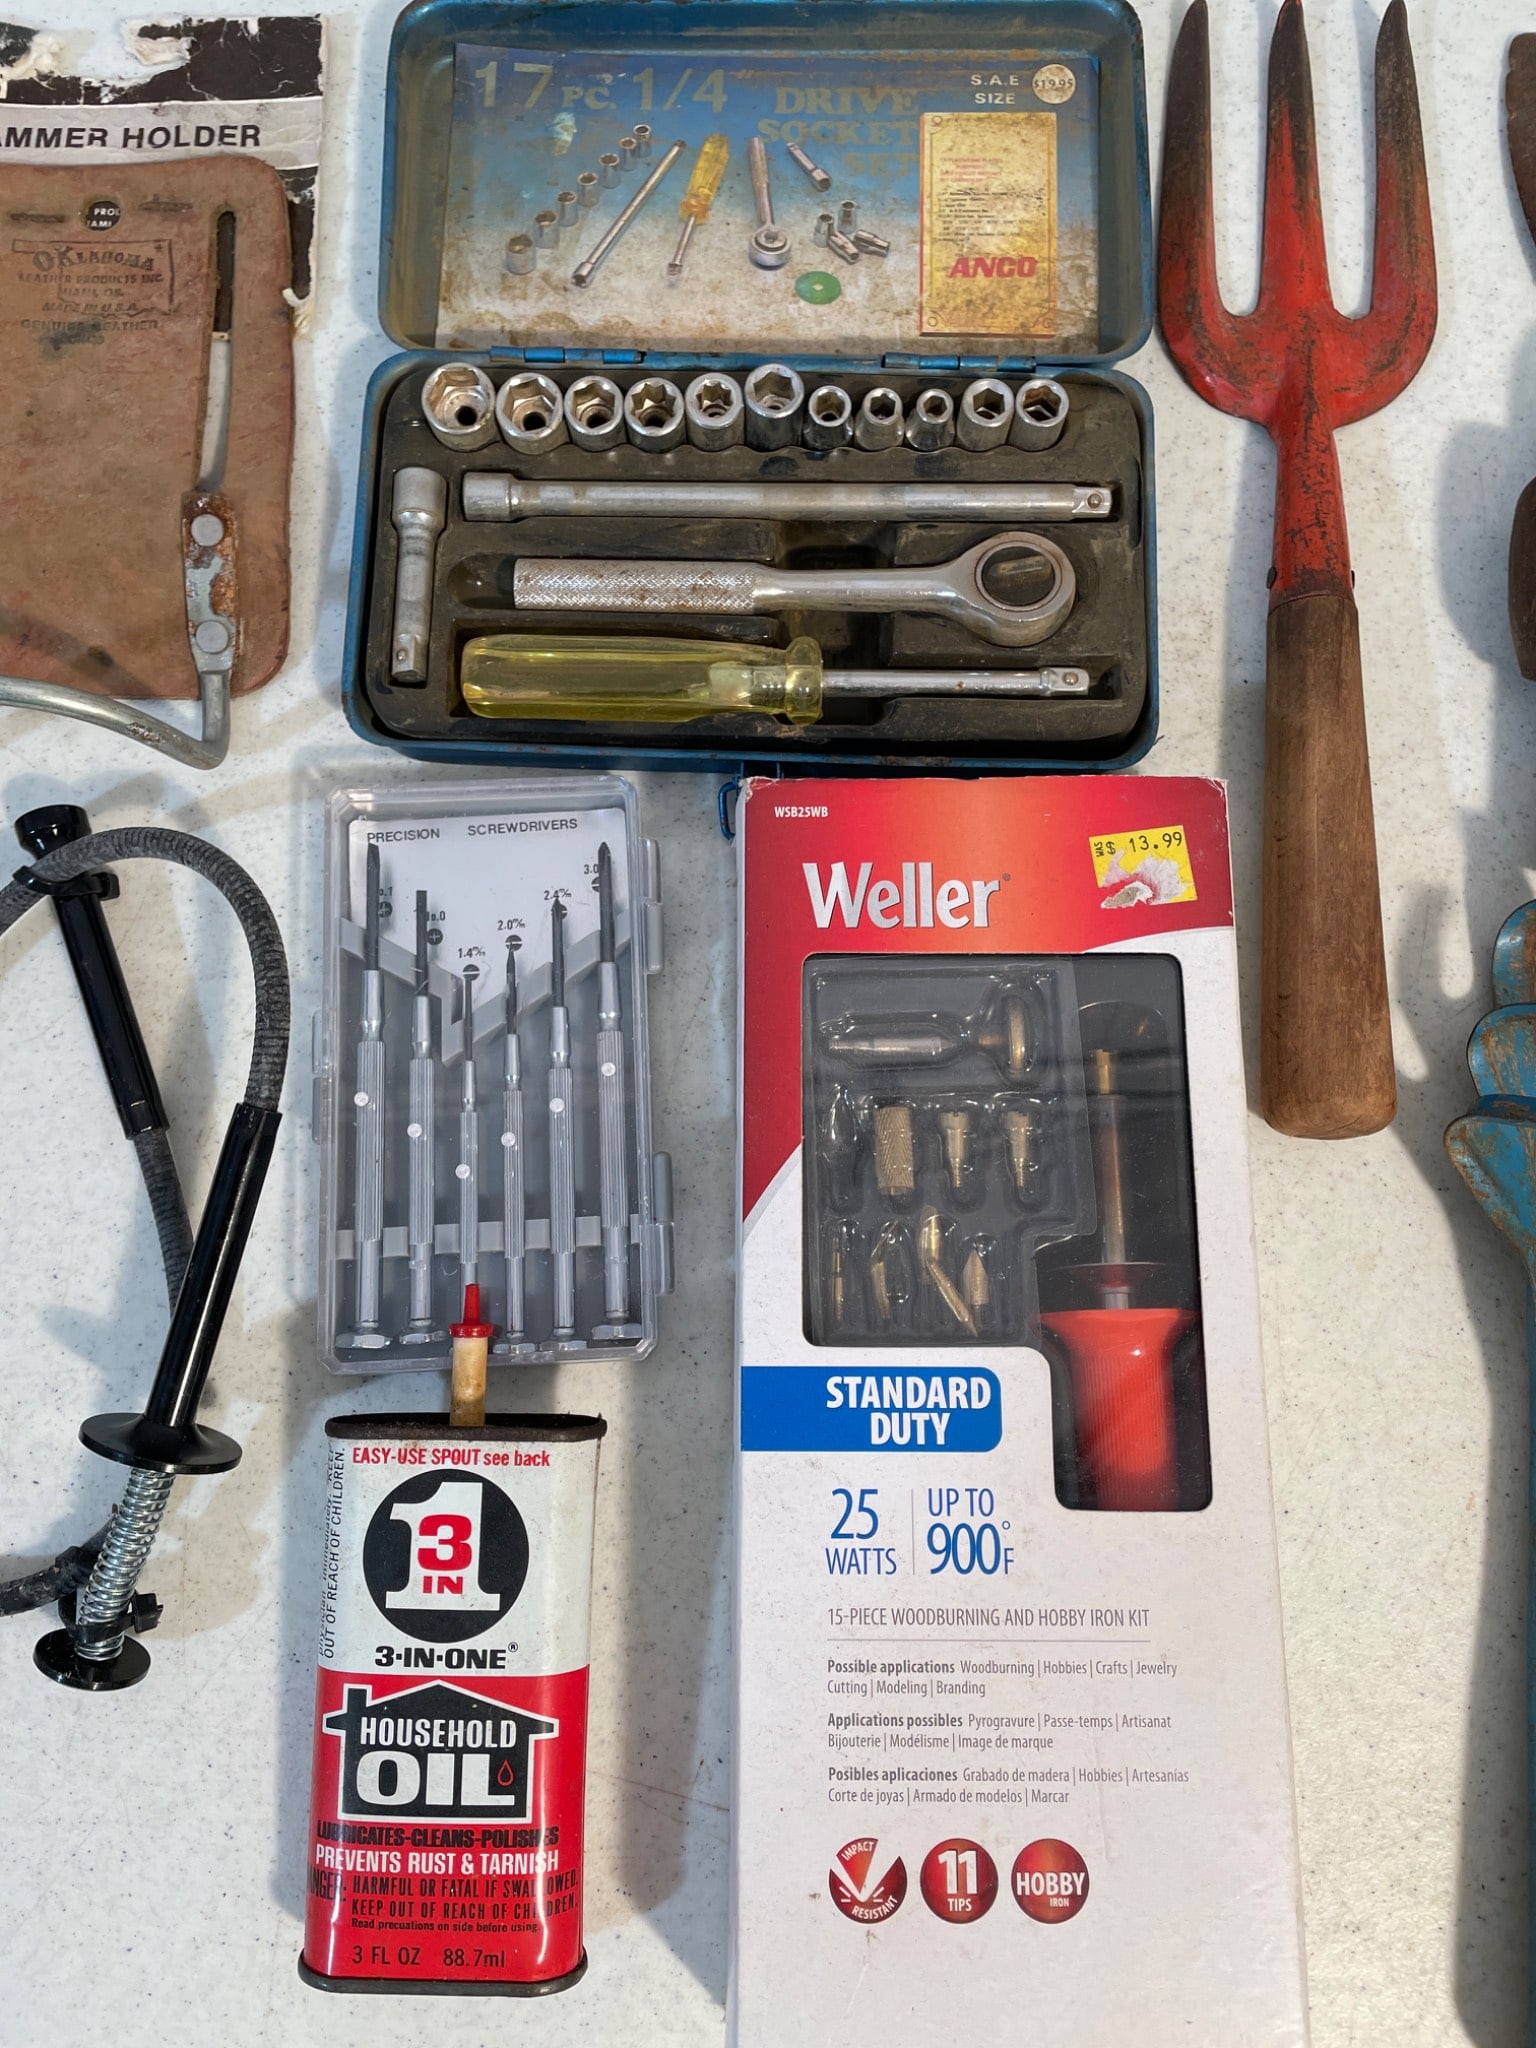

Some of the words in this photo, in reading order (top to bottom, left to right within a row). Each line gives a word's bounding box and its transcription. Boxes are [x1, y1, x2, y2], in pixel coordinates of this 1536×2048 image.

[475, 61, 553, 109] 17
[775, 86, 919, 115] DRIVE
[975, 92, 1016, 105] SIZE
[122, 125, 261, 149] HOLDER
[757, 119, 918, 146] SOCKET
[844, 153, 918, 177] SET
[33, 245, 154, 272] OKLAHOMA
[949, 256, 1039, 279] ANCO
[774, 806, 829, 819] WSB25WB
[366, 828, 441, 844] PRECISION
[467, 818, 578, 836] SCREWDRIVERS
[1128, 831, 1183, 853] 13.99
[802, 861, 1000, 929] Weller
[826, 1376, 991, 1409] STANDARD
[870, 1412, 951, 1446] DUTY
[352, 1447, 426, 1466] EASY-USE
[431, 1449, 481, 1466] SPOUT
[483, 1452, 509, 1466] see
[514, 1451, 551, 1467] back
[331, 1448, 346, 1527] CHILDREN.
[830, 1488, 880, 1540] 25
[928, 1488, 959, 1516] UP
[965, 1488, 994, 1516] TO
[330, 1528, 341, 1549] OF
[417, 1514, 473, 1572] 3
[826, 1547, 897, 1575] WATTS
[329, 1552, 340, 1601] REACH
[422, 1575, 463, 1595] IN
[327, 1604, 337, 1625] OF
[827, 1608, 887, 1627] 15-PIECE
[892, 1608, 1000, 1628] WOODBURNING
[1004, 1609, 1034, 1627] AND
[1038, 1609, 1086, 1628] HOBBY
[1090, 1609, 1124, 1628] IRON
[1128, 1609, 1150, 1628] KIT
[324, 1626, 335, 1659] OUT
[827, 1659, 877, 1674] Possible
[880, 1660, 955, 1676] applications
[960, 1660, 1035, 1677] Woodburning
[1043, 1661, 1087, 1675] Hobbies
[1095, 1661, 1128, 1675] Crafts
[1136, 1661, 1177, 1678] Jewelry
[827, 1680, 868, 1697] Cutting
[876, 1680, 928, 1697] Modeling
[936, 1681, 986, 1698] Branding
[360, 1717, 517, 1748] HOUSEHOLD
[827, 1713, 904, 1730] Applications
[907, 1714, 963, 1731] possibles
[968, 1715, 1035, 1731] Pyrogravure
[1044, 1715, 1113, 1732] Passe-temps
[1122, 1715, 1172, 1729] Artisanat
[828, 1734, 881, 1751] Bijouterie
[890, 1734, 949, 1749] Modélisme
[958, 1735, 992, 1752] Image
[995, 1735, 1008, 1750] de
[1011, 1738, 1054, 1753] marque
[356, 1751, 515, 1806] OIL
[828, 1767, 878, 1782] Posibles
[881, 1768, 958, 1785] aplicaciones
[963, 1768, 1009, 1783] Grabado
[1012, 1768, 1025, 1783] de
[1028, 1769, 1070, 1784] madera
[1079, 1769, 1123, 1784] Hobbies
[828, 1788, 857, 1803] Corte
[860, 1788, 873, 1803] de
[875, 1789, 905, 1806] joyas
[913, 1788, 956, 1803] Armado
[959, 1788, 972, 1803] de
[975, 1788, 1022, 1804] modelos
[1031, 1789, 1069, 1804] Marcar
[316, 1844, 402, 1873] PREVENTS
[408, 1852, 456, 1875] RUST
[461, 1853, 474, 1875] &
[480, 1849, 559, 1875] TARNISH
[841, 1841, 875, 1861] IMPACT
[353, 1875, 414, 1896] HARMFUL
[420, 1879, 437, 1896] OR
[441, 1880, 480, 1898] FATAL
[485, 1880, 498, 1897] IF
[502, 1869, 578, 1898] SWALOWED.
[938, 1849, 978, 1895] 11
[1016, 1871, 1086, 1896] HOBBY
[352, 1899, 384, 1916] KEEP
[389, 1901, 414, 1918] OUT
[421, 1902, 437, 1918] OF
[443, 1902, 485, 1920] REACH
[492, 1903, 507, 1920] OF
[851, 1895, 899, 1920] RESISTANT
[948, 1898, 972, 1912] TIPS
[1050, 1897, 1070, 1908] IRON
[351, 1918, 375, 1929] Read
[378, 1920, 435, 1931] precuations
[437, 1923, 450, 1931] on
[453, 1922, 474, 1932] side
[476, 1922, 508, 1932] before
[352, 1946, 363, 1964] 3
[371, 1947, 391, 1965] FL
[397, 1948, 421, 1966] OZ
[443, 1950, 505, 1968] 88.7ml
